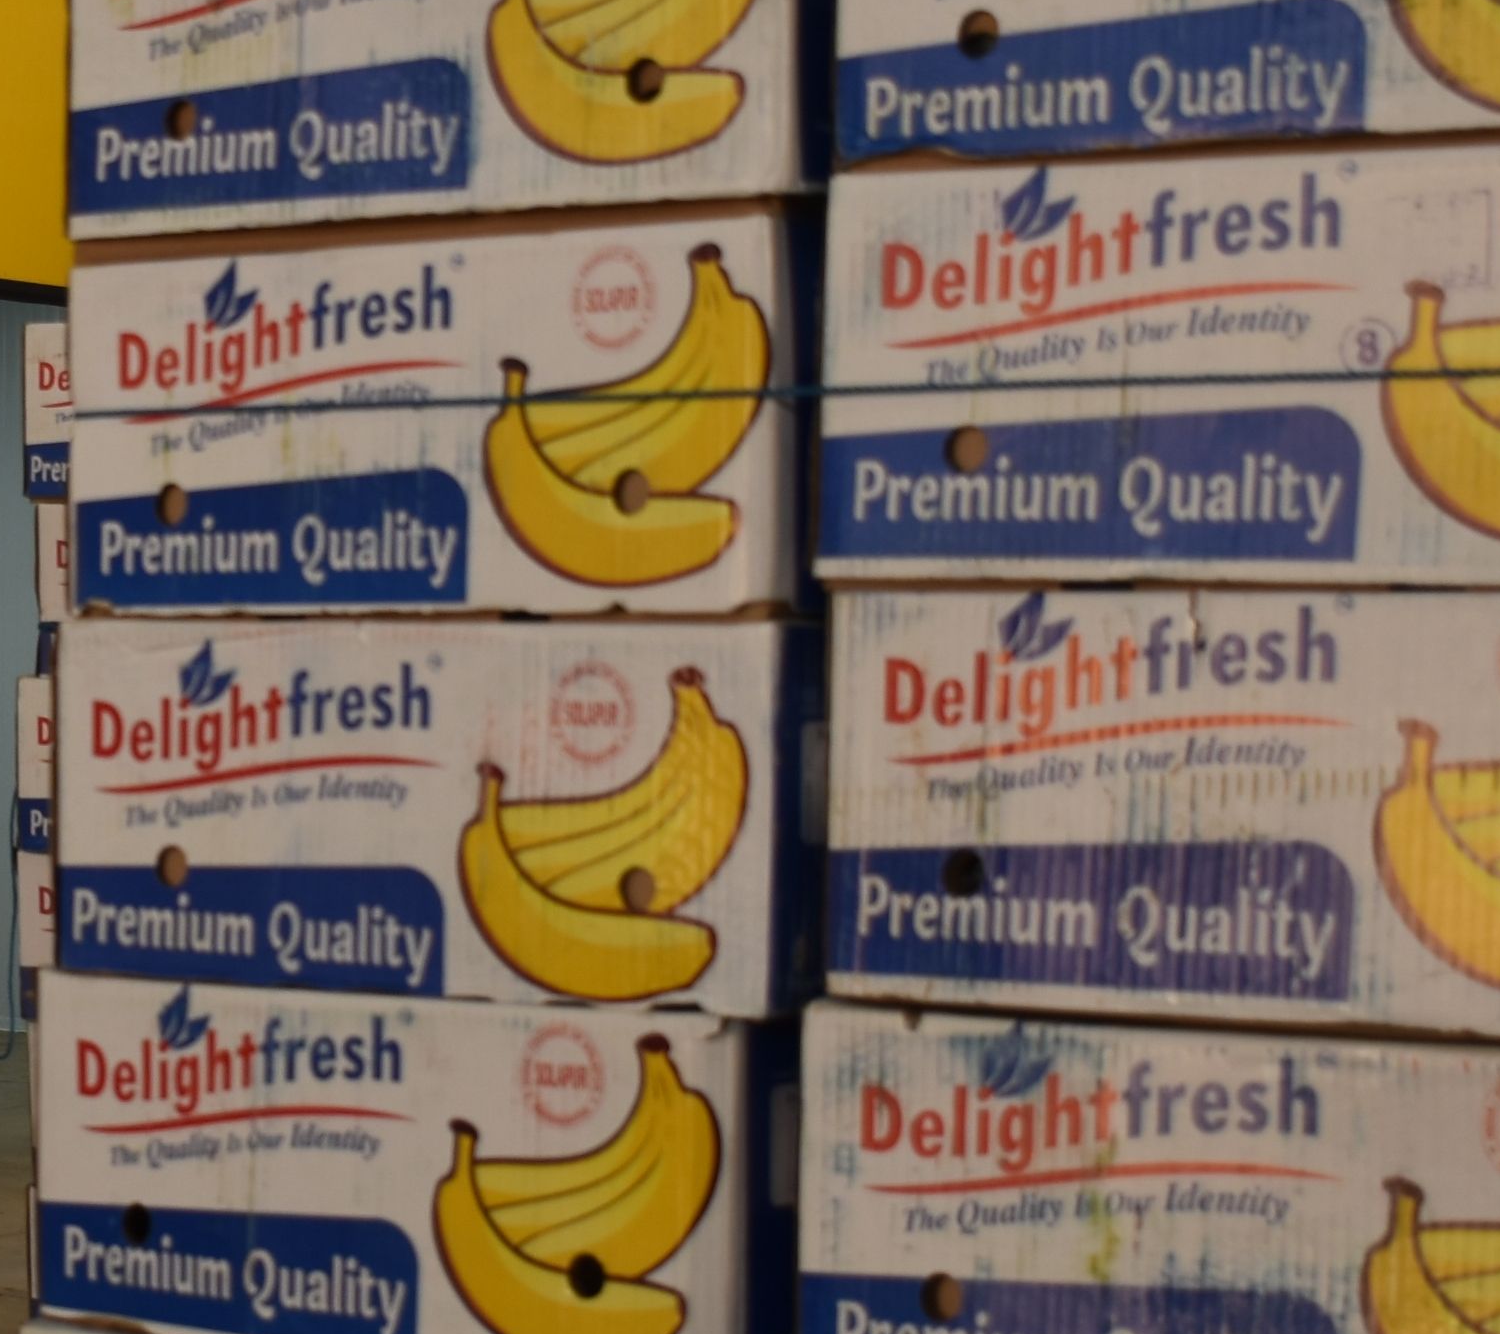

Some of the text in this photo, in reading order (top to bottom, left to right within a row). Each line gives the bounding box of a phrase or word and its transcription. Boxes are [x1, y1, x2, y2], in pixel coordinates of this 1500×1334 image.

[149, 33, 180, 58] The
[186, 8, 265, 52] Quality
[863, 47, 1348, 136] Premium Quality
[94, 102, 456, 179] Premium Quality
[879, 173, 1341, 313] Delightfresh
[117, 265, 451, 391] Delightfresh
[978, 334, 1086, 379] Quality
[1187, 302, 1313, 336] Identity
[151, 429, 183, 454] The
[189, 409, 267, 449] Quality
[850, 455, 1341, 543] Premium Quality
[97, 511, 454, 588] Premium Quality
[882, 606, 1335, 736] Delightfresh
[92, 663, 430, 771] Delightfresh
[126, 803, 158, 826] The
[164, 791, 243, 826] Quality
[317, 774, 410, 803] Identity
[978, 758, 1084, 800] Quality
[1183, 736, 1308, 769] Identity
[71, 888, 430, 987] Premium Quality
[853, 874, 1335, 981] Premium Quality
[77, 1015, 400, 1115] Delightfresh
[111, 1144, 141, 1166] The
[146, 1136, 221, 1168] Quality
[292, 1124, 381, 1156] Identity
[859, 1059, 1317, 1173] Delightfresh
[906, 1206, 949, 1232] The
[957, 1196, 1065, 1234] Quality
[1165, 1183, 1291, 1220] Identity
[61, 1225, 234, 1300] Premium
